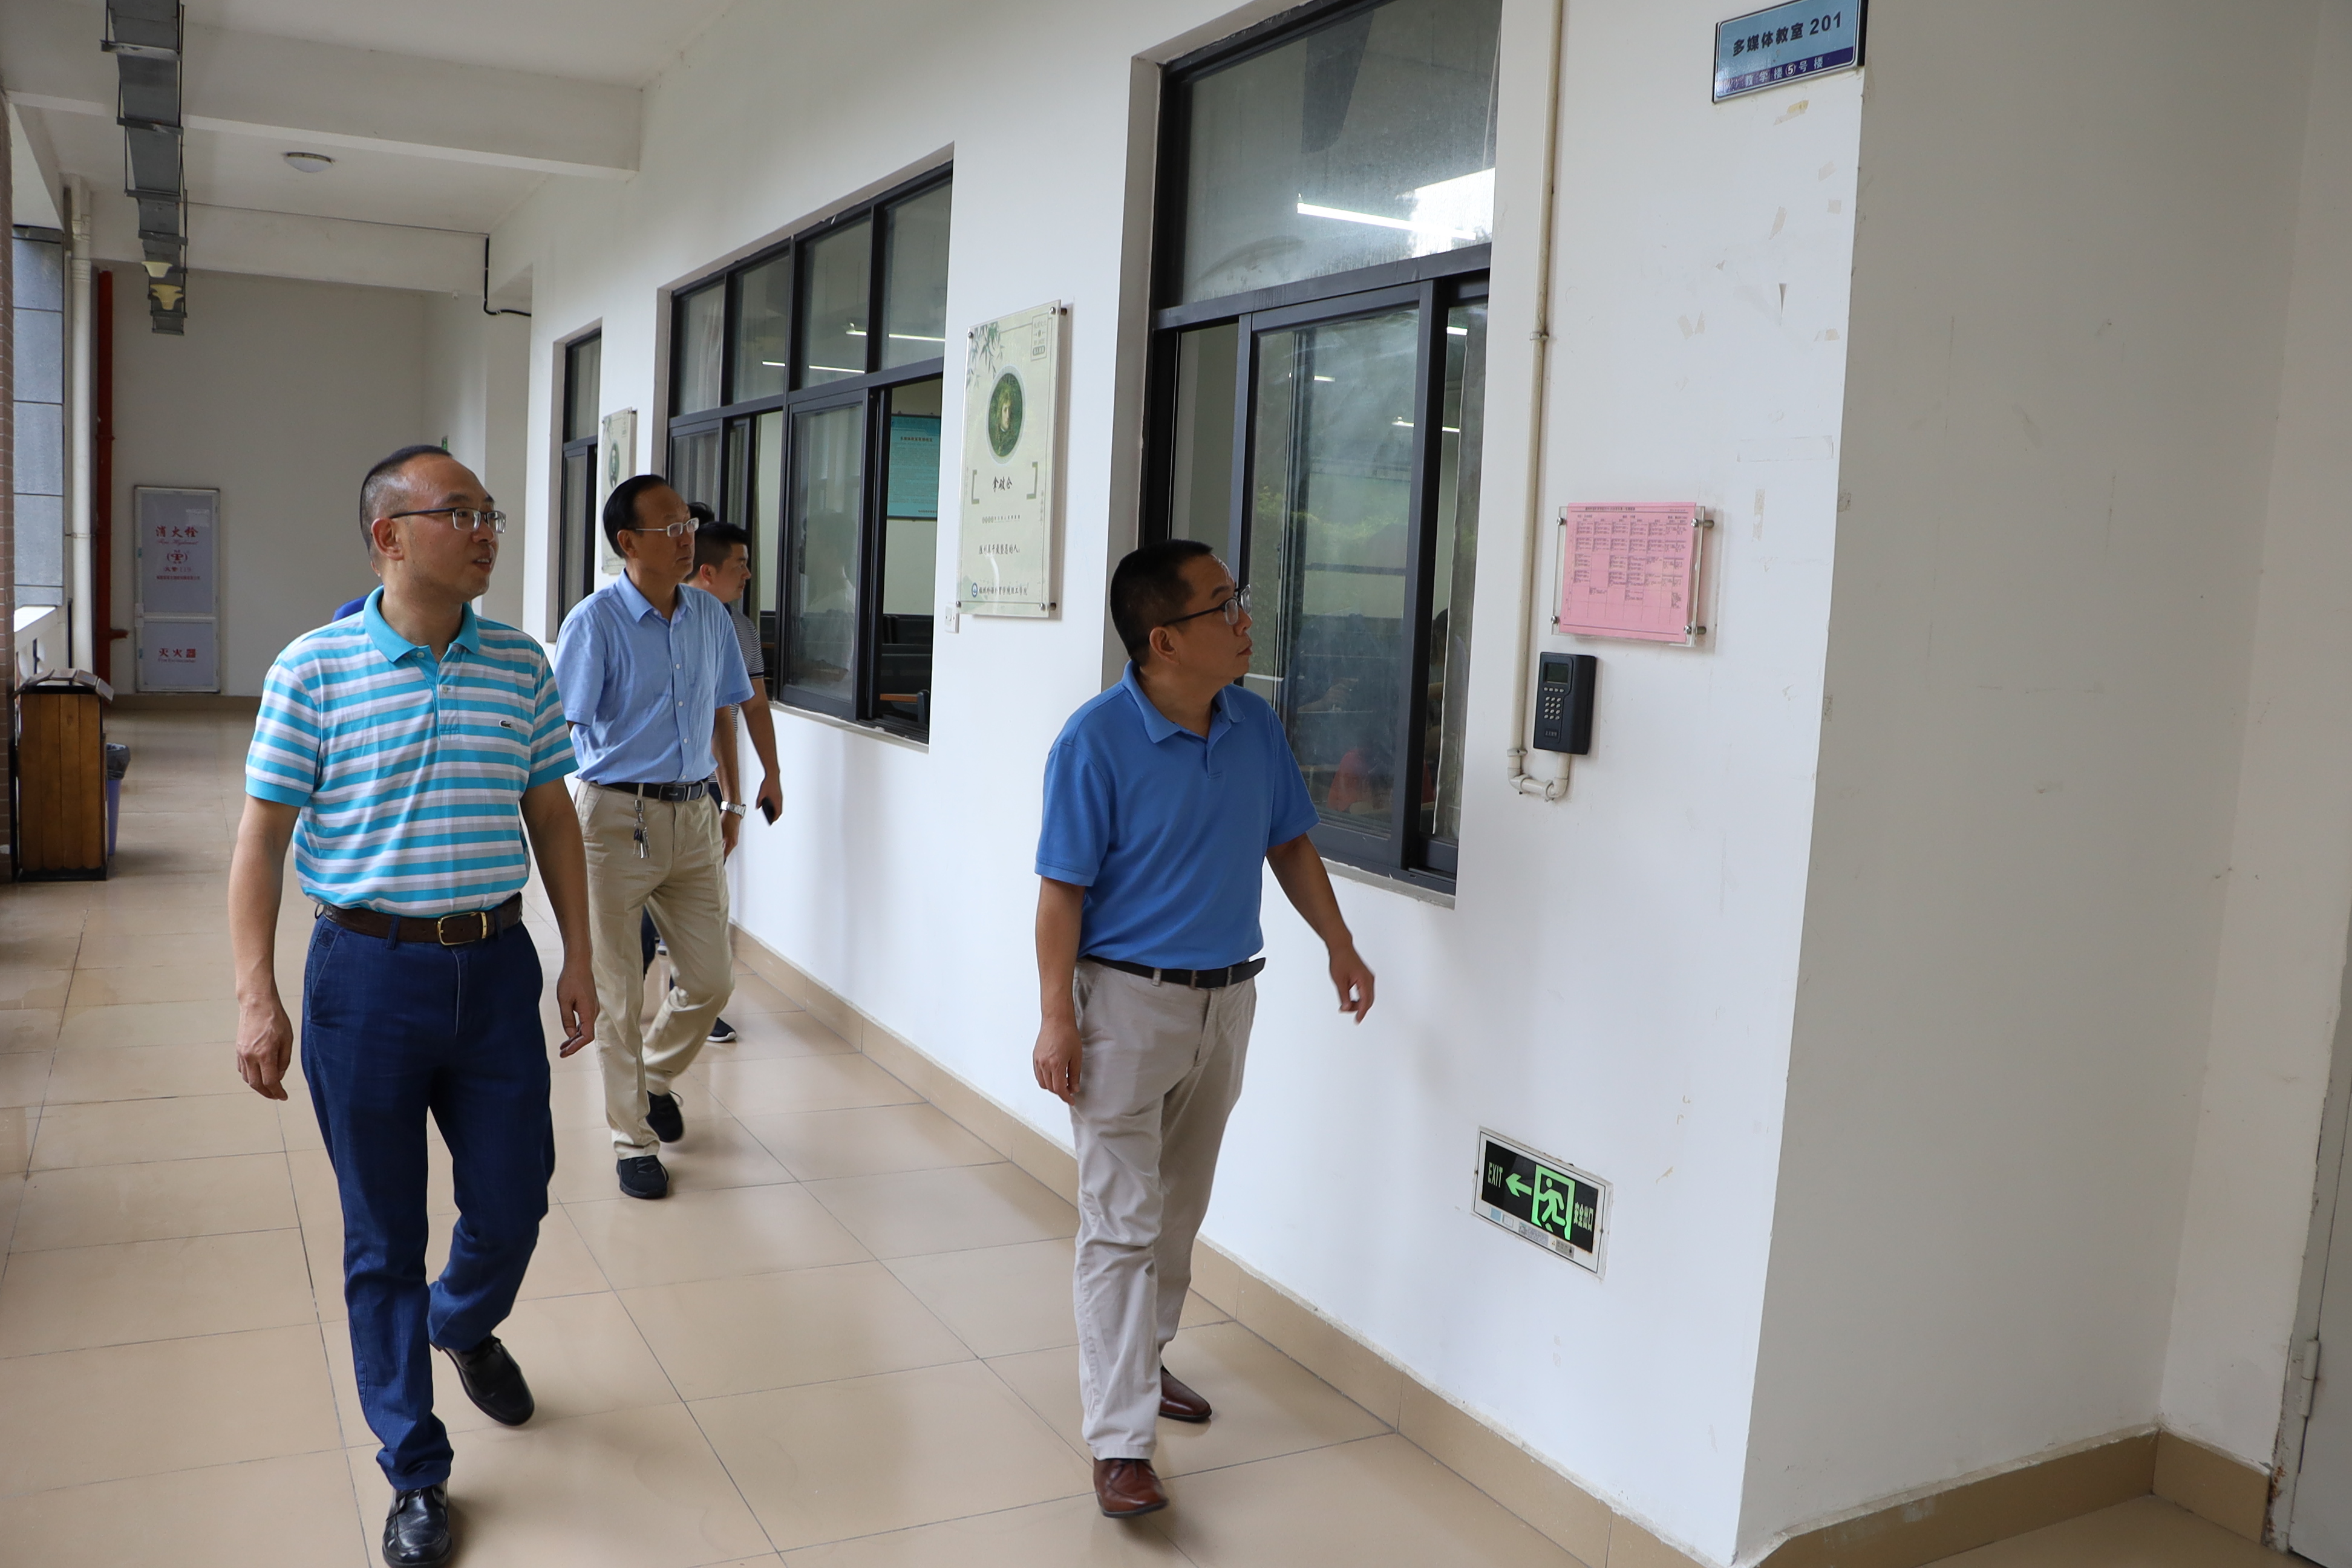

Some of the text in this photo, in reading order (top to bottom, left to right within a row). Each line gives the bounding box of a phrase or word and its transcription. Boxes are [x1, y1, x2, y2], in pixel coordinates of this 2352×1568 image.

[1733, 11, 1841, 57] 多媒体教室 201
[155, 525, 199, 538] 消火栓
[158, 648, 197, 659] 灭火器
[1488, 1161, 1503, 1188] EXIT
[1573, 1201, 1594, 1232] 安全出口
